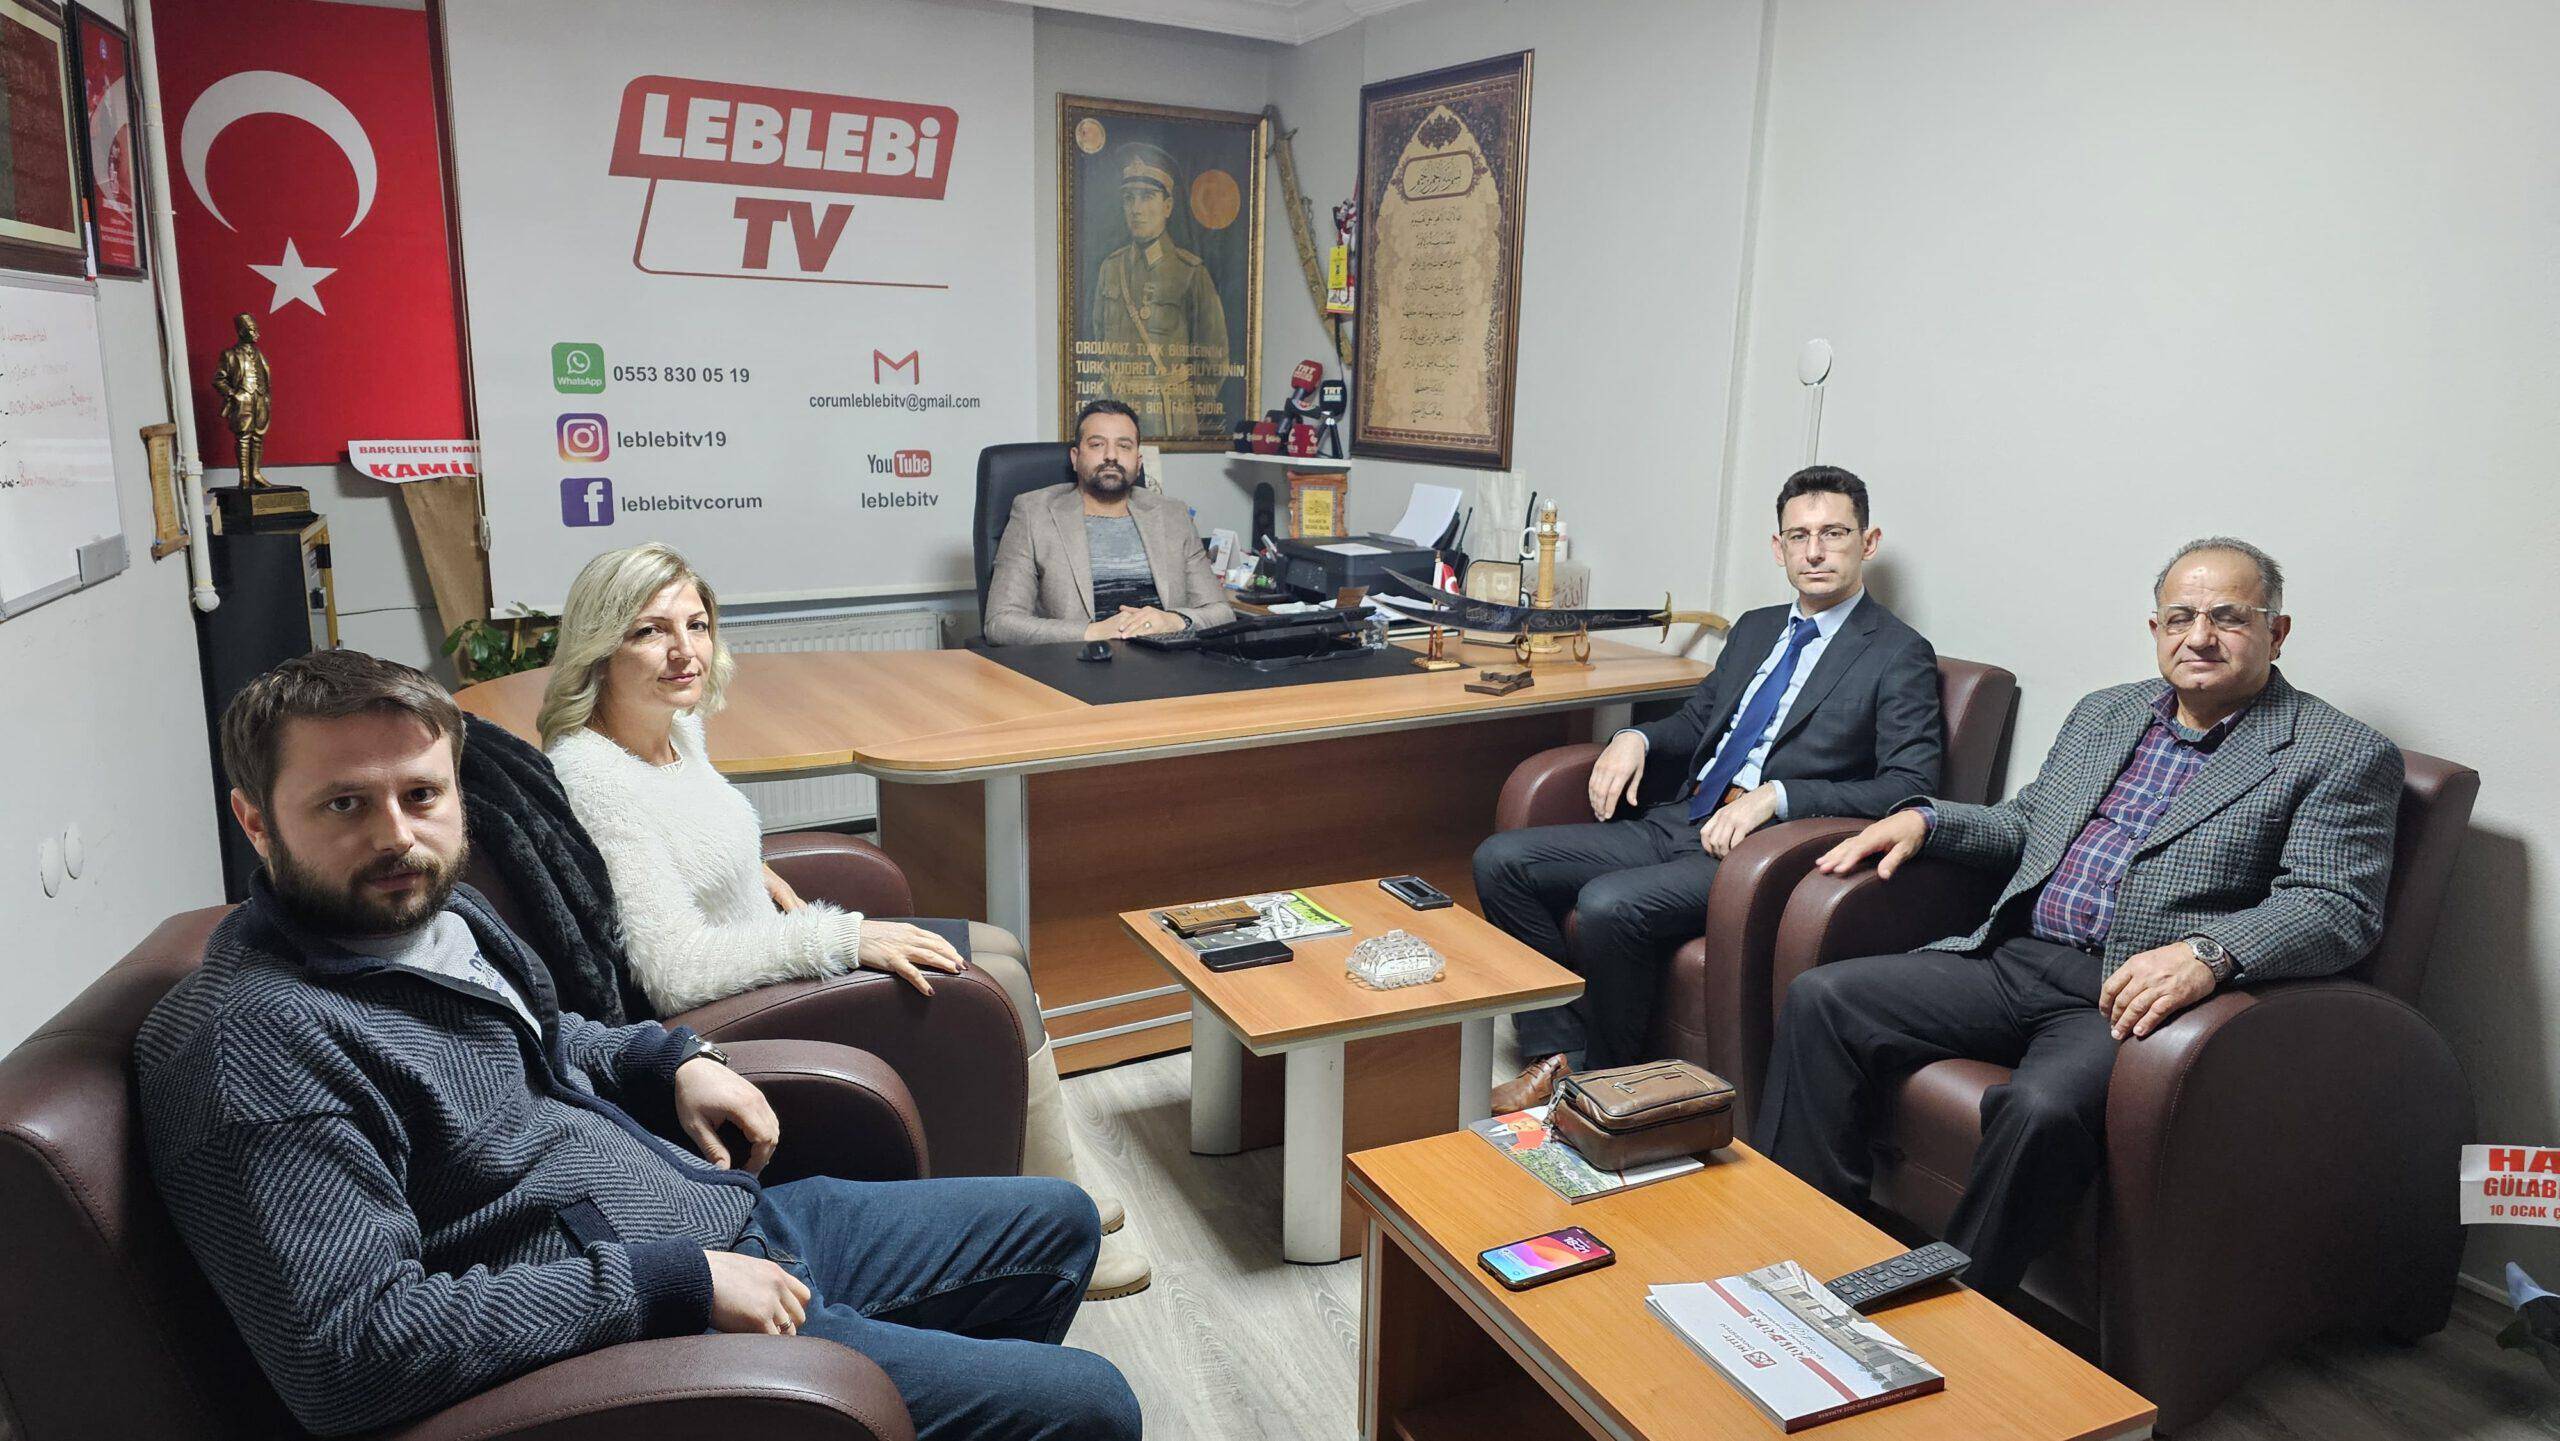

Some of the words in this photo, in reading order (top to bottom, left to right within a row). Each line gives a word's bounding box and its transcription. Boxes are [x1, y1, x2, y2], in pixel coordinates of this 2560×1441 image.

[734, 196, 855, 272] TV
[557, 376, 603, 387] WhatsApp
[613, 365, 658, 382] 0553
[664, 366, 696, 383] 830
[702, 367, 723, 383] 05
[730, 368, 750, 383] 19
[809, 393, 981, 412] corumleblebitv@gmail.com
[617, 431, 727, 448] leblebitv19
[359, 445, 449, 455] BAHÇELİEVLER
[622, 495, 763, 512] leblebitvcorum
[861, 491, 939, 508] leblebitv
[2483, 1174, 2560, 1199] GÜLAB
[2490, 1204, 2504, 1216] 10
[2510, 1205, 2547, 1218] OCAK
